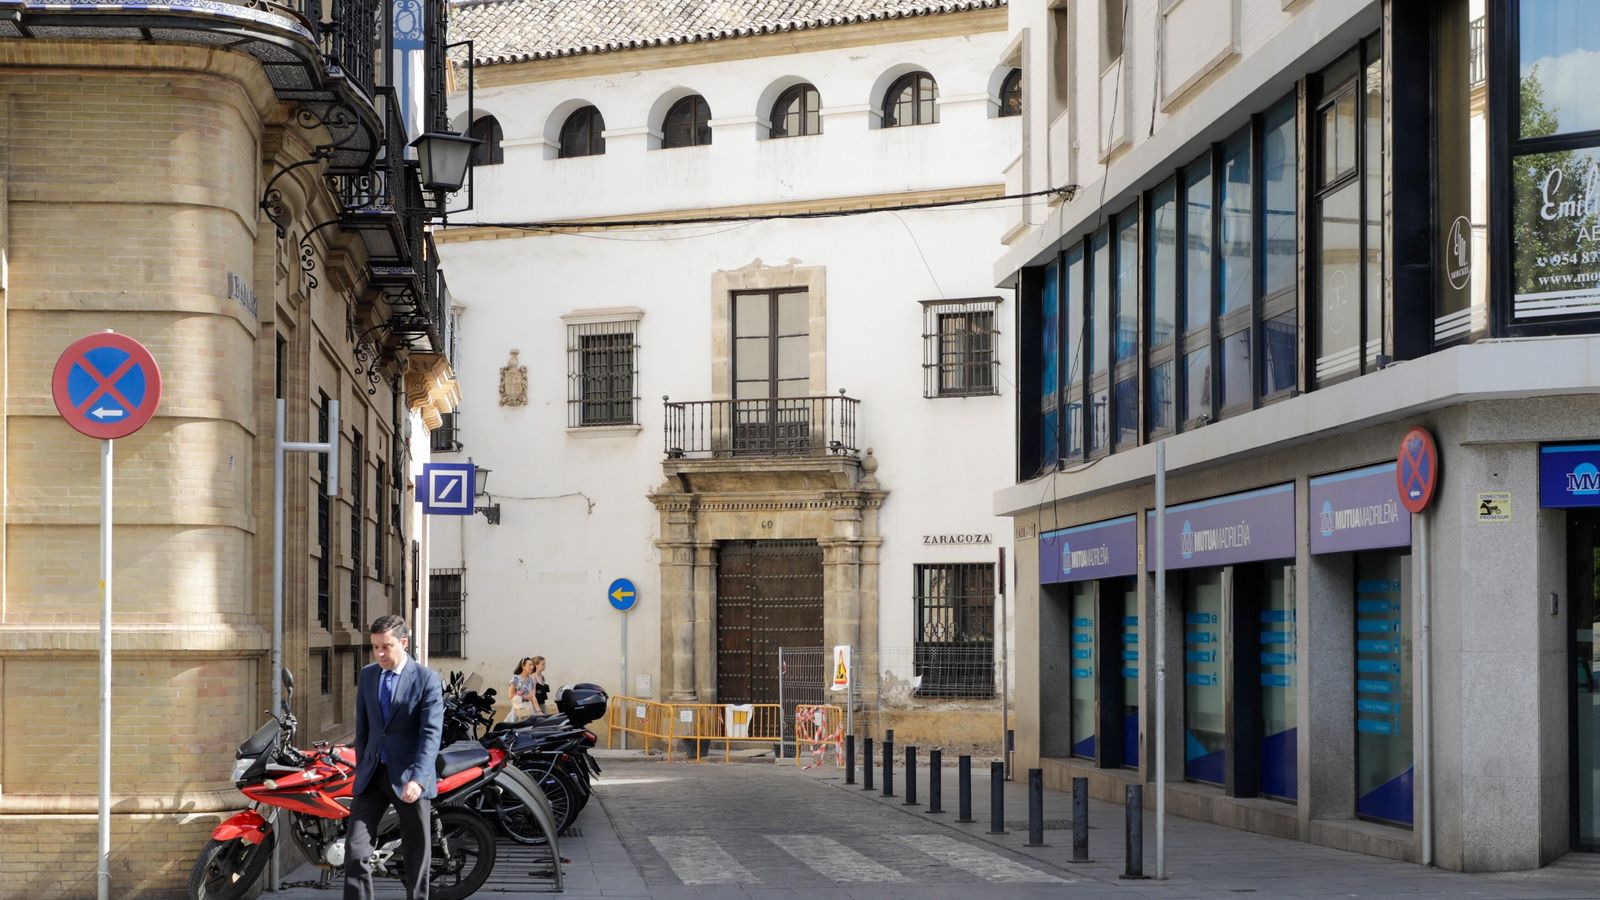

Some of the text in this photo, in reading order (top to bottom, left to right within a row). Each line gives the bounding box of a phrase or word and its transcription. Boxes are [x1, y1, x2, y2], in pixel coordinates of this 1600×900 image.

[1550, 253, 1577, 267] 954
[1538, 271, 1600, 286] www.mo
[923, 534, 990, 544] ZARAGOZA
